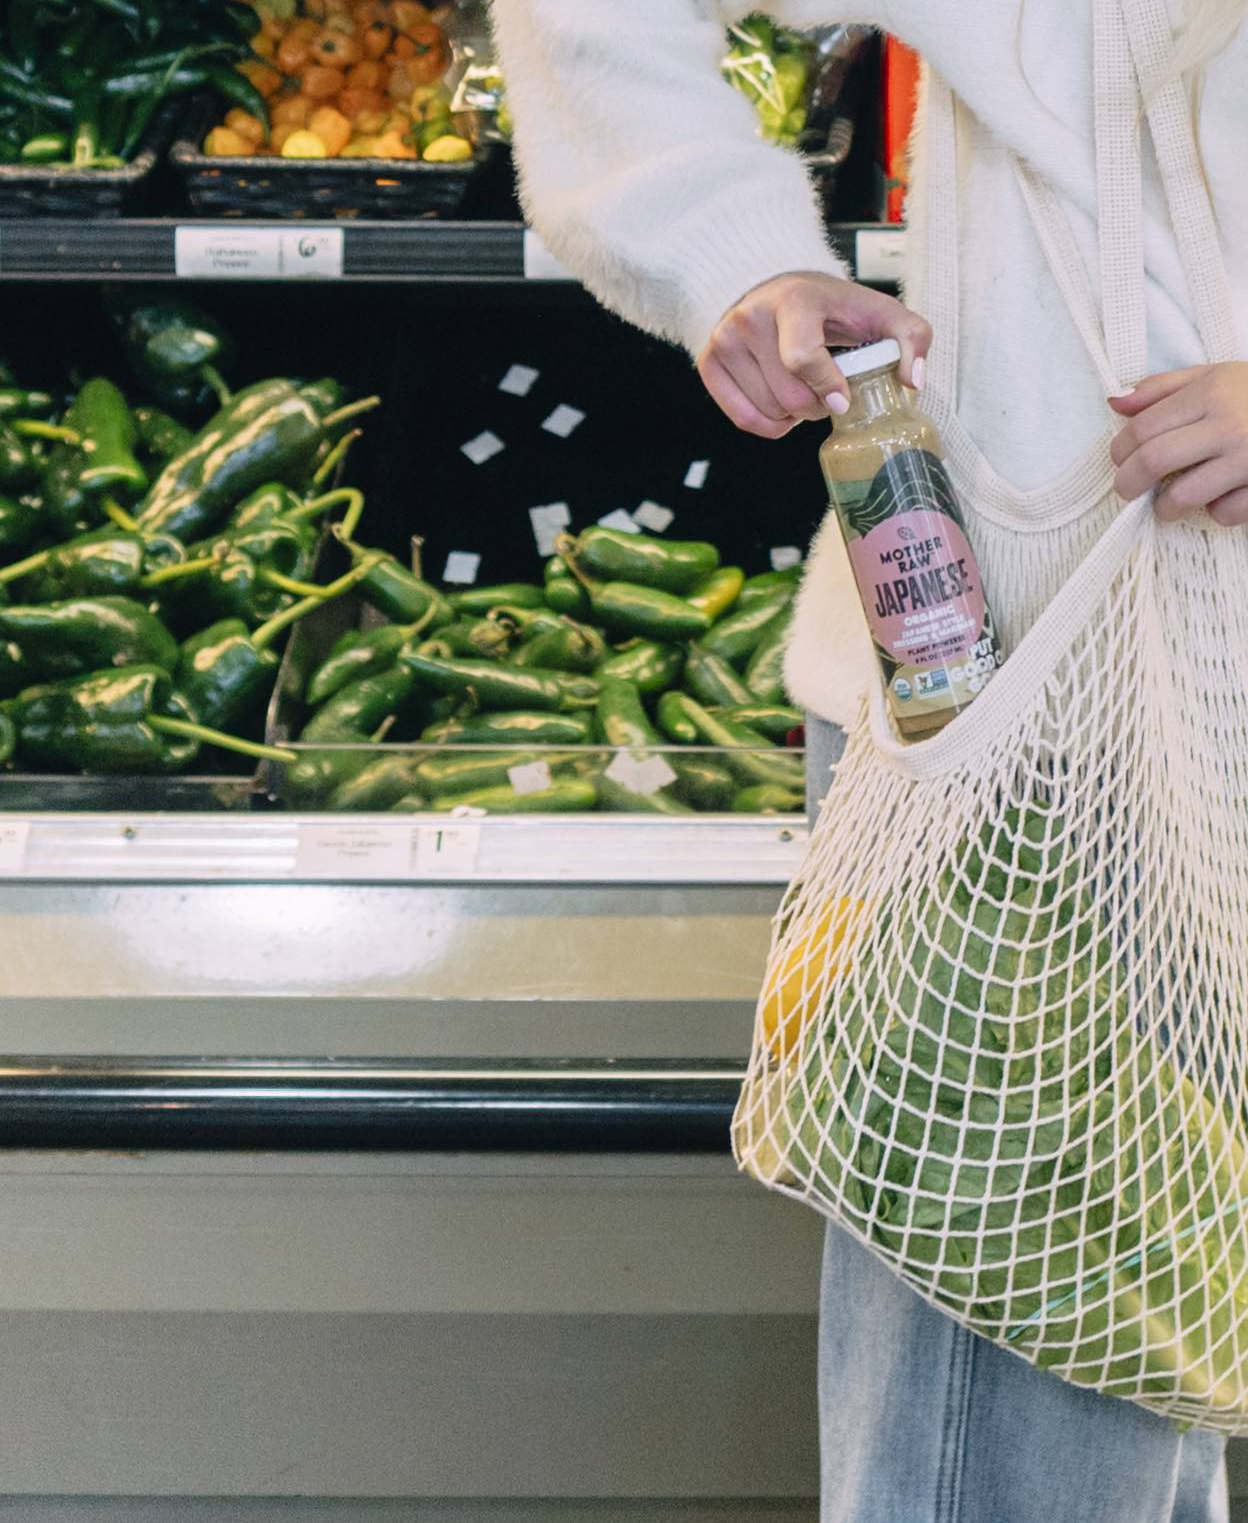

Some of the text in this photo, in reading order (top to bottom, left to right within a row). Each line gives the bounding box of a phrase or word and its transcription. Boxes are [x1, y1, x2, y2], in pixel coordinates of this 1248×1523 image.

[879, 536, 943, 565] MOTHER
[898, 554, 932, 574] RAW
[875, 558, 974, 618] JAPANESE
[969, 637, 994, 659] PUT
[950, 653, 996, 682] GOOD
